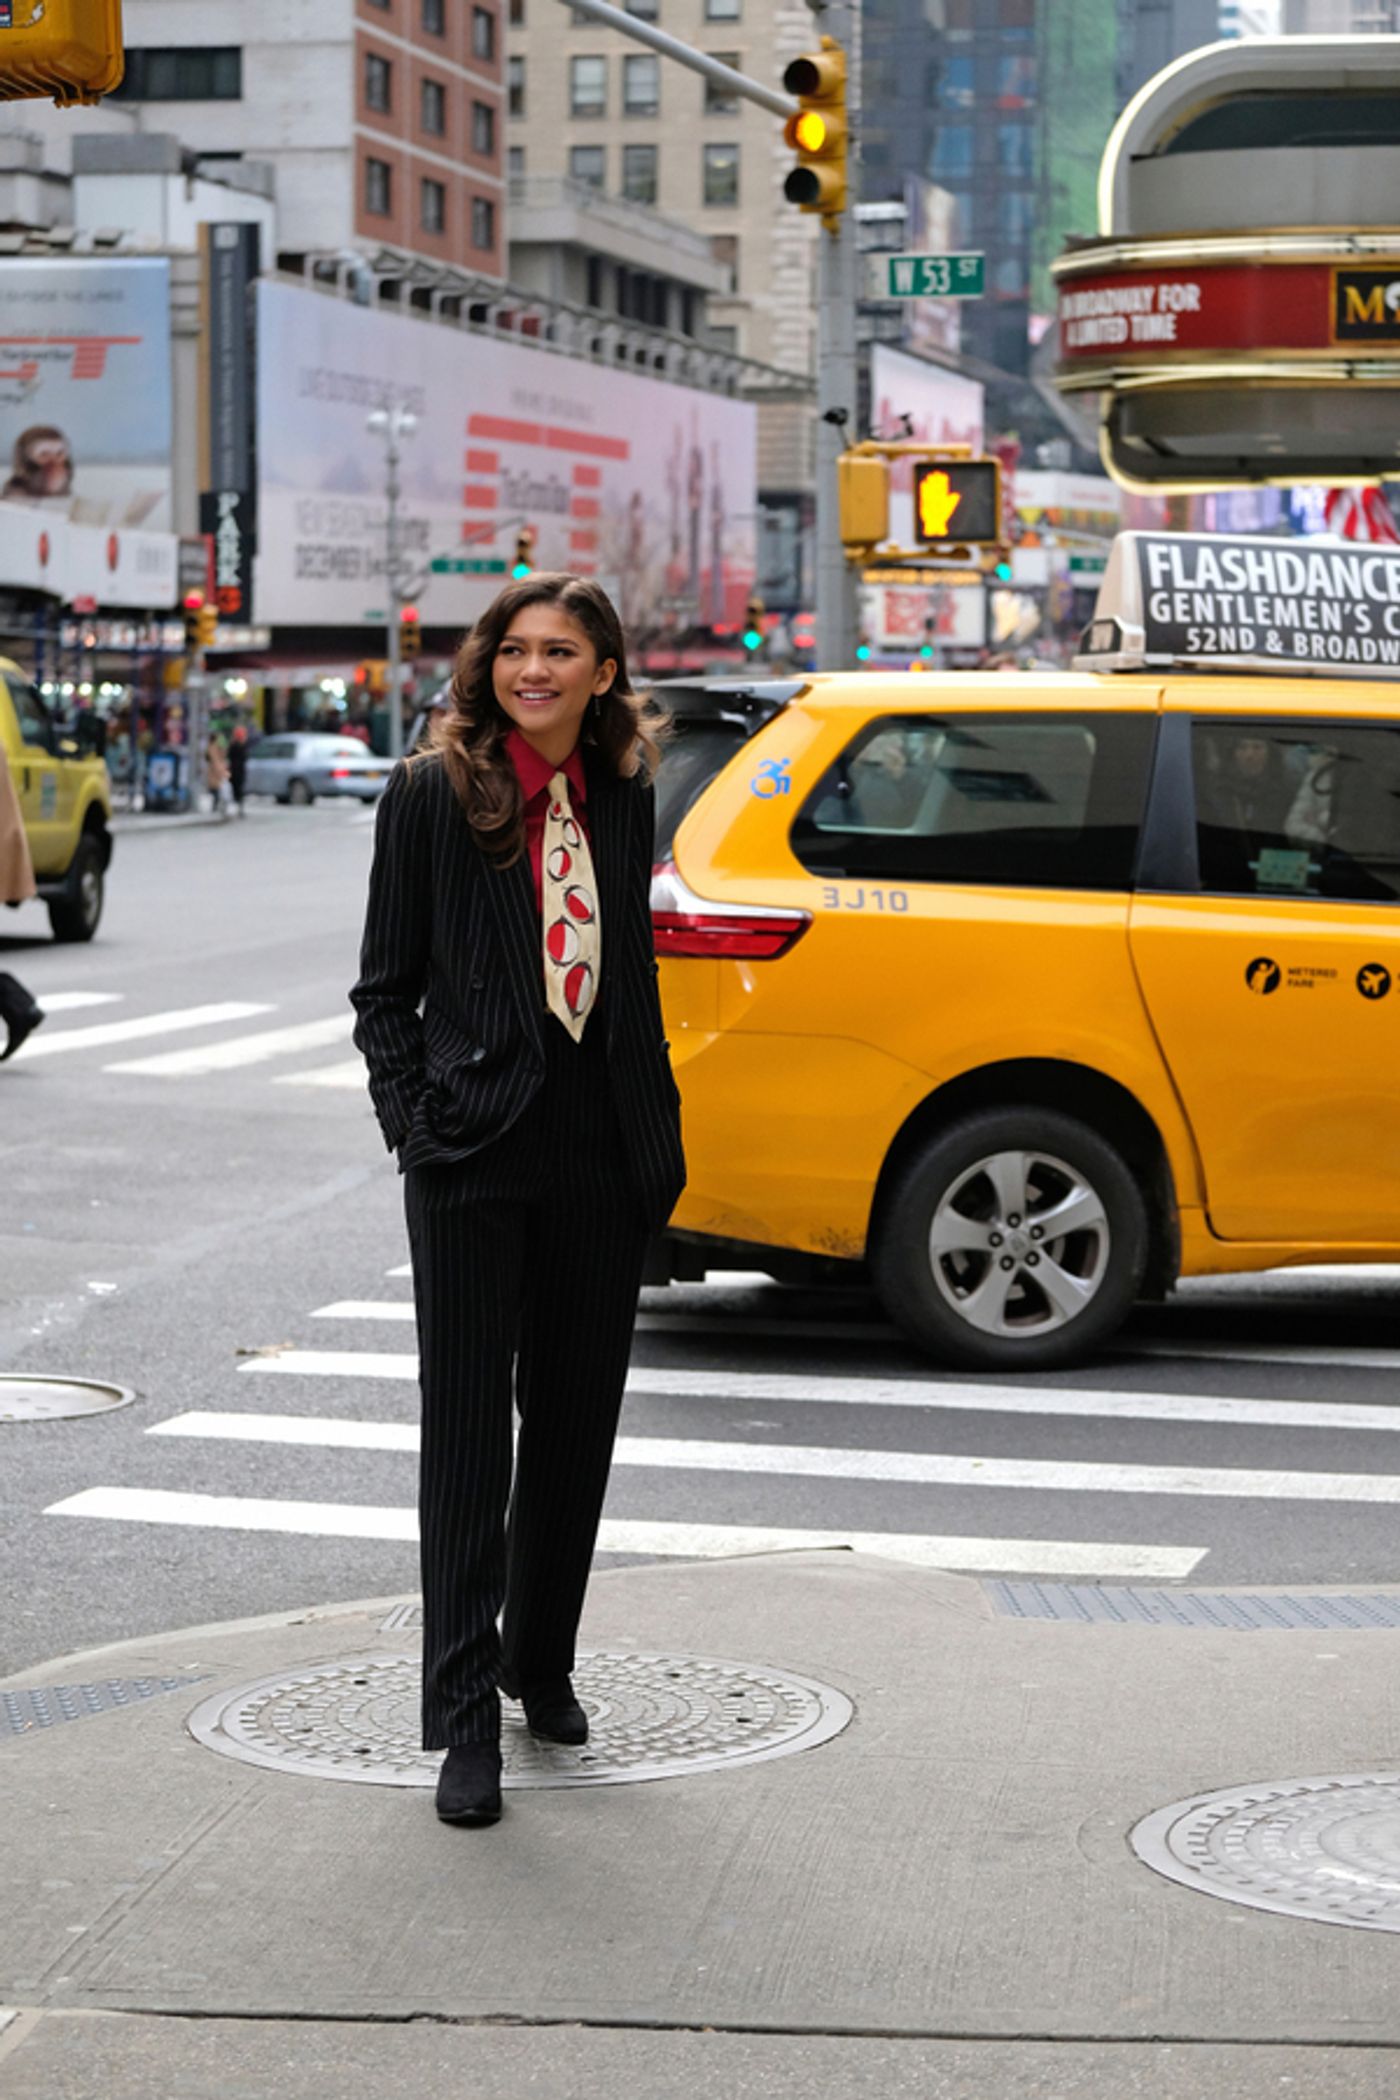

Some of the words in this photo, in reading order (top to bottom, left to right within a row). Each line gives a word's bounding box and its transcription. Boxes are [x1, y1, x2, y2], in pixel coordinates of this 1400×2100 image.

[894, 261, 915, 293] W
[922, 259, 950, 294] 53
[959, 259, 978, 277] ST
[1158, 283, 1201, 312] FOR
[1131, 312, 1177, 342] TIME
[217, 491, 241, 587] PARK
[1147, 543, 1400, 603] FLASHDANCE
[1150, 591, 1373, 635] GENTLEMEN'S
[1186, 627, 1257, 653] 52ND
[1264, 629, 1284, 654] &
[1293, 632, 1400, 664] BROADW
[822, 886, 909, 912] 3J10
[1288, 967, 1338, 979] METERED
